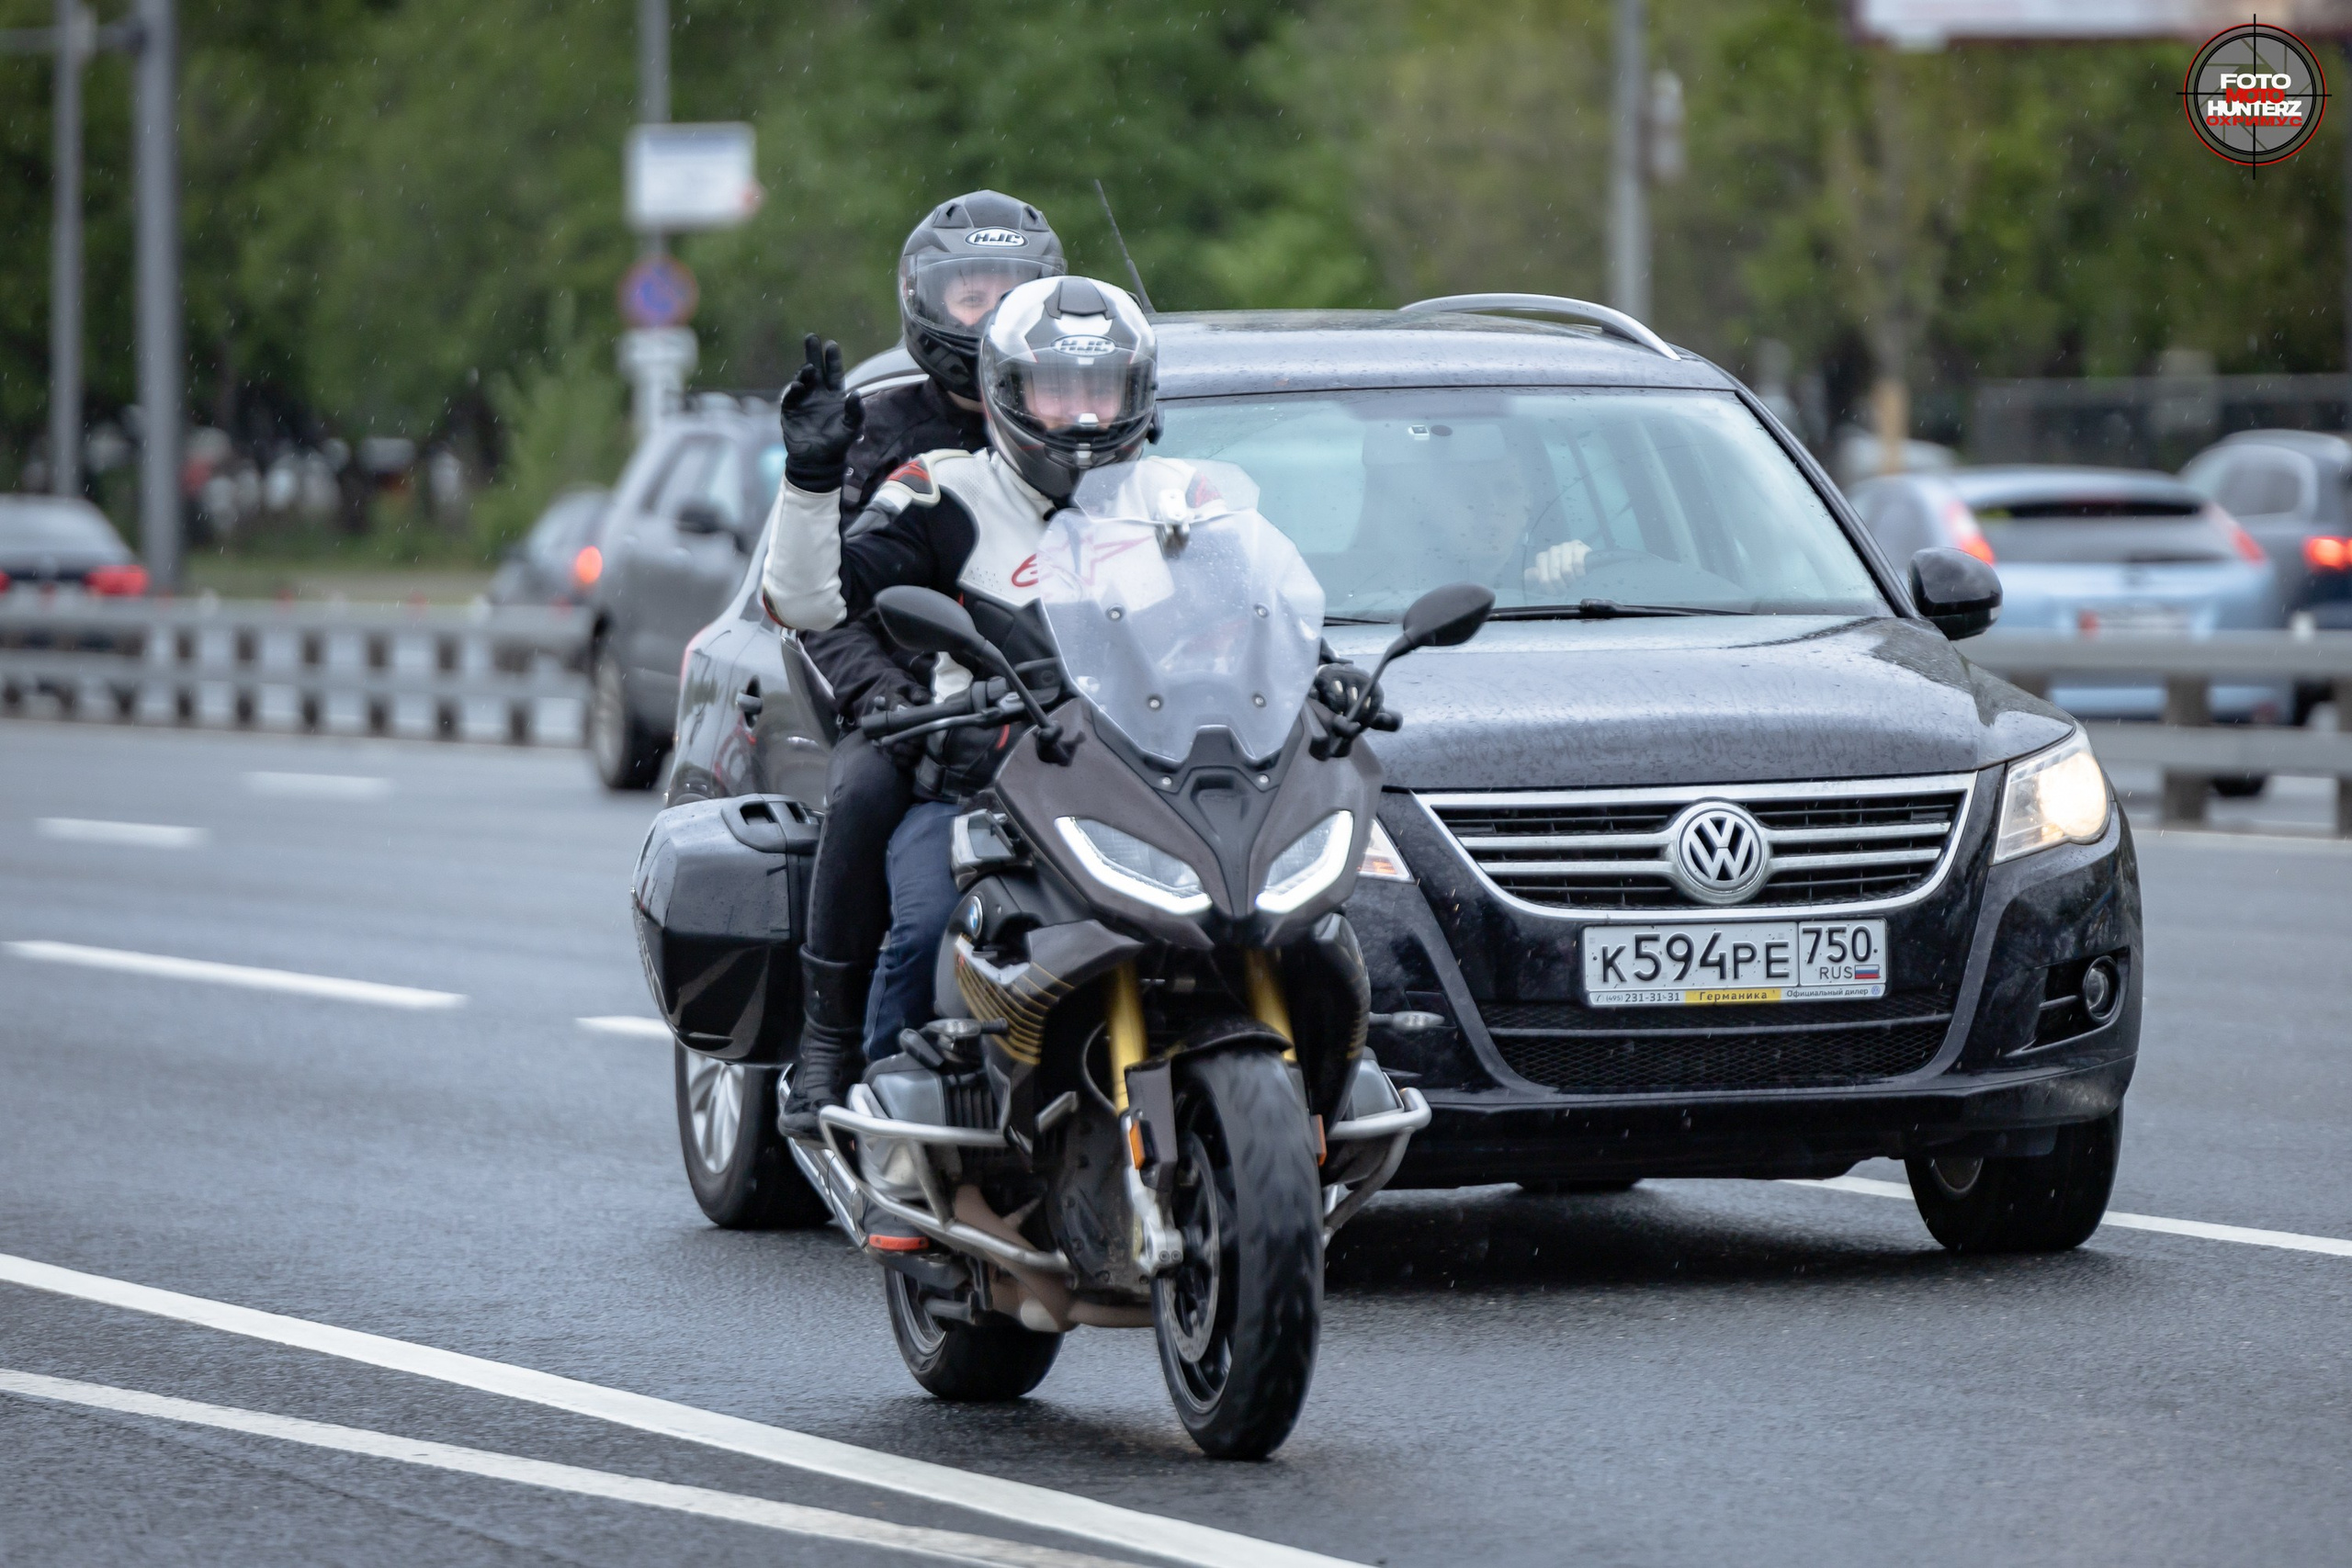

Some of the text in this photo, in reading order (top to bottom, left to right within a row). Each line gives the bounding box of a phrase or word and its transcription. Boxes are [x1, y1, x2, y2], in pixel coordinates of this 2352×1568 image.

[973, 232, 1021, 244] HJC
[1059, 339, 1112, 352] HJC
[1802, 925, 1873, 964] 750
[1819, 965, 1853, 980] RUS
[1700, 990, 1768, 1003] Германика
[1786, 987, 1869, 998] Официальный дилер
